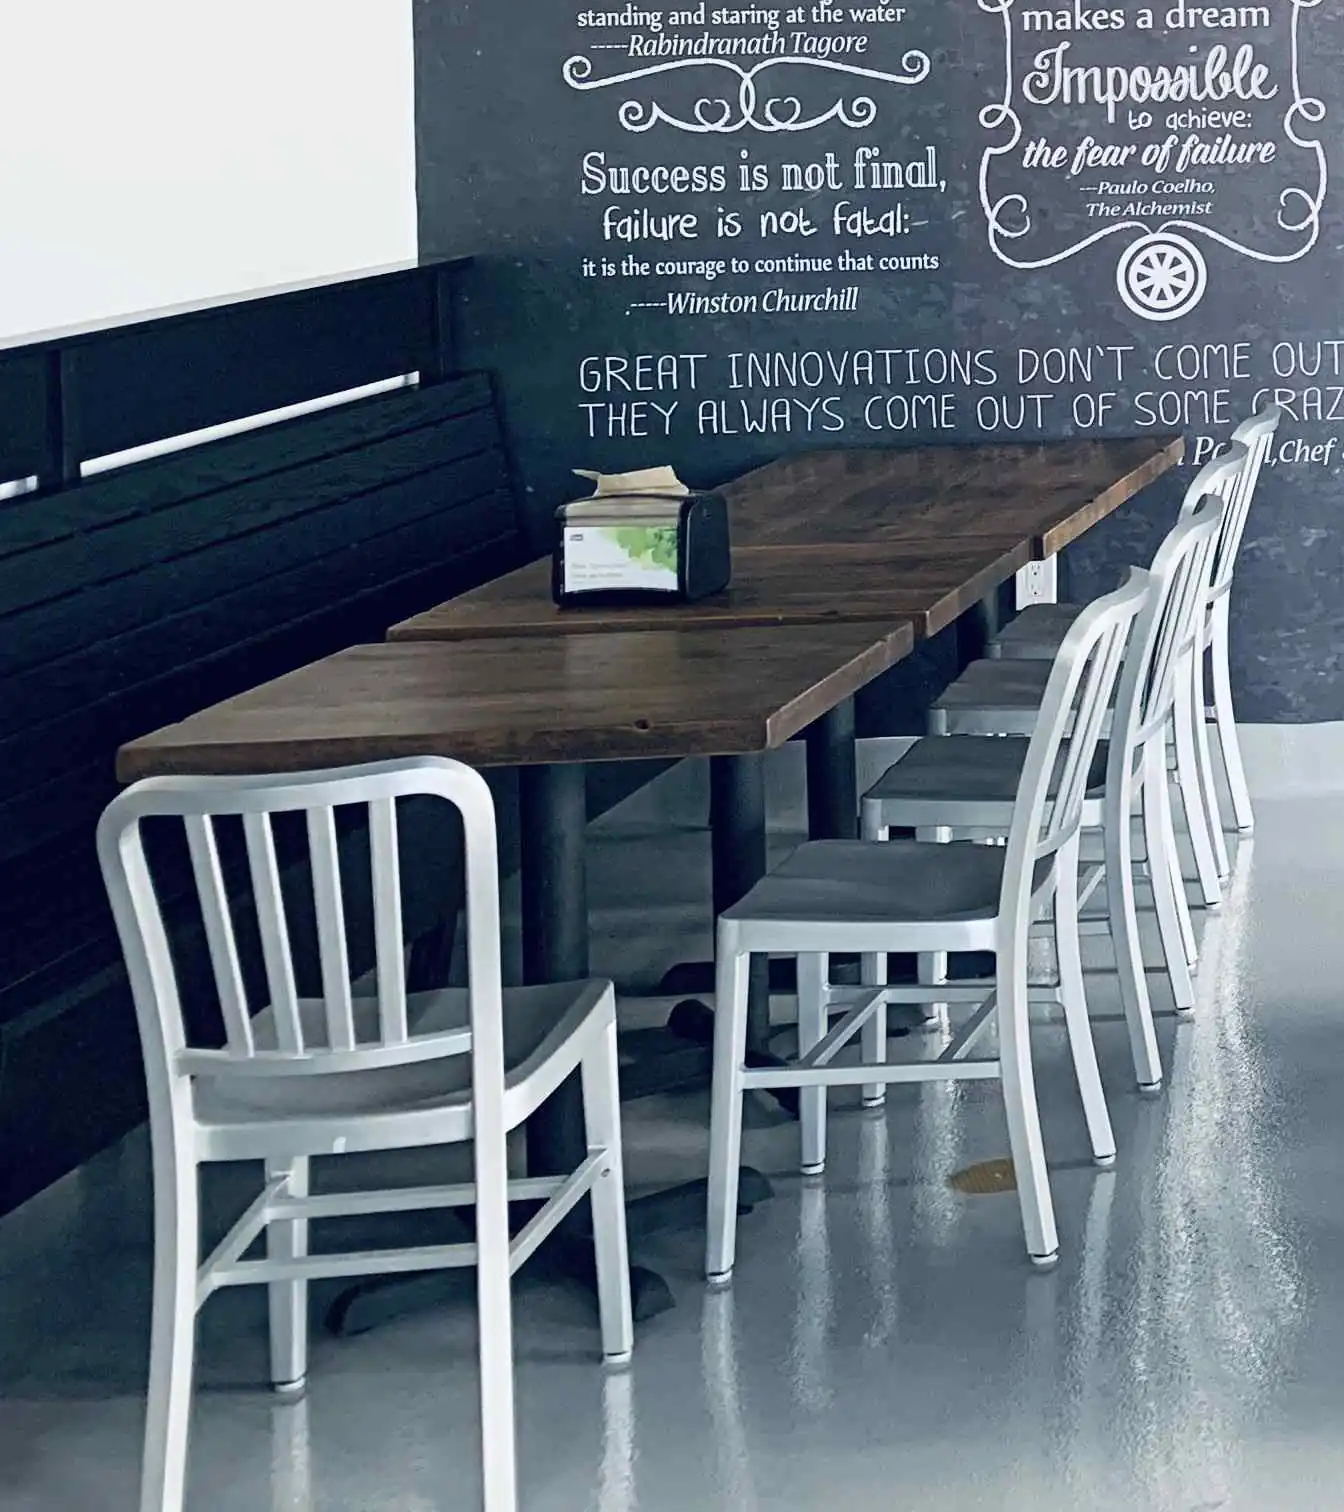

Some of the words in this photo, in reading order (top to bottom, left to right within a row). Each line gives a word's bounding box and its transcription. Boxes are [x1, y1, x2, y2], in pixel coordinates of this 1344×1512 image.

[577, 2, 663, 33] standing
[668, 1, 705, 25] and
[711, 7, 781, 31] staring
[785, 6, 806, 24] at
[811, 4, 844, 23] the
[848, 5, 906, 23] water
[1136, 8, 1153, 29] a
[1085, 202, 1121, 217] The
[1121, 200, 1214, 217] Alchemist
[582, 257, 597, 277] it
[601, 257, 617, 277] is
[620, 254, 651, 276] the
[655, 260, 726, 281] courage
[730, 257, 750, 274] to
[754, 253, 833, 273] continue
[837, 249, 875, 271] that
[878, 253, 939, 271] counts
